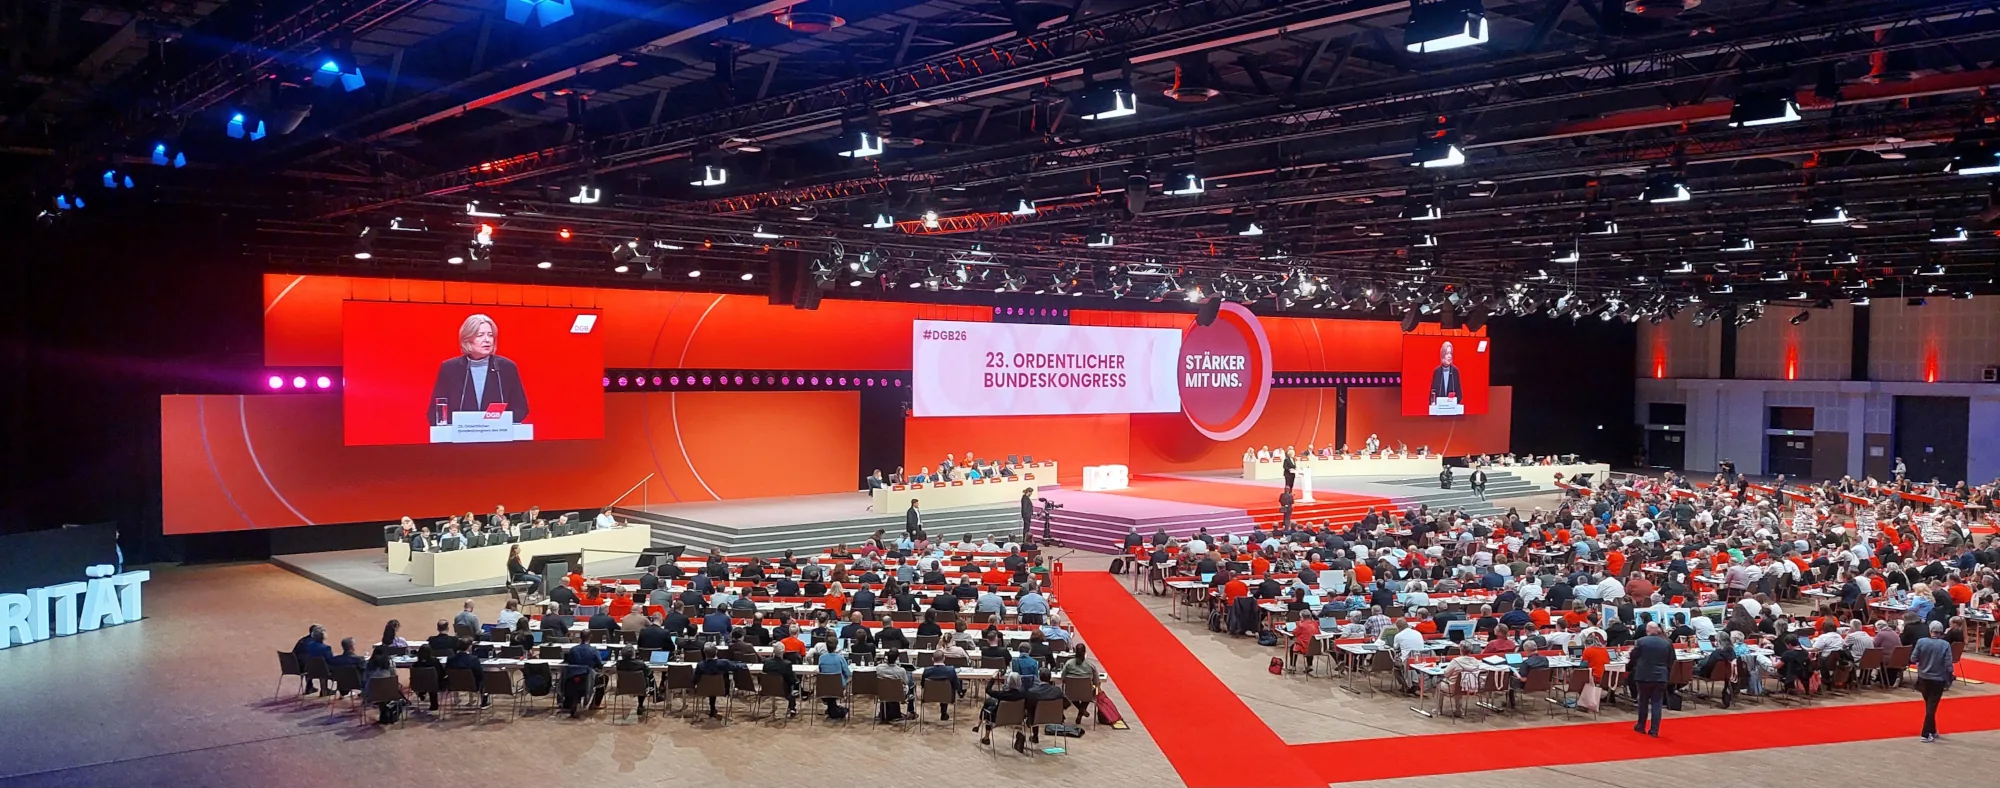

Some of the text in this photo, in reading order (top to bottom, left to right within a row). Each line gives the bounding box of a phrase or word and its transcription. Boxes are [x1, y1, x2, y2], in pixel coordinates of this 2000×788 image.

[923, 330, 967, 340] #DGB26
[986, 352, 1125, 369] 23. ORDENTLICHER
[1185, 351, 1245, 370] STÄRKER
[984, 373, 1126, 388] BUNDESKONGRESS
[1185, 373, 1243, 388] MIT UNS.
